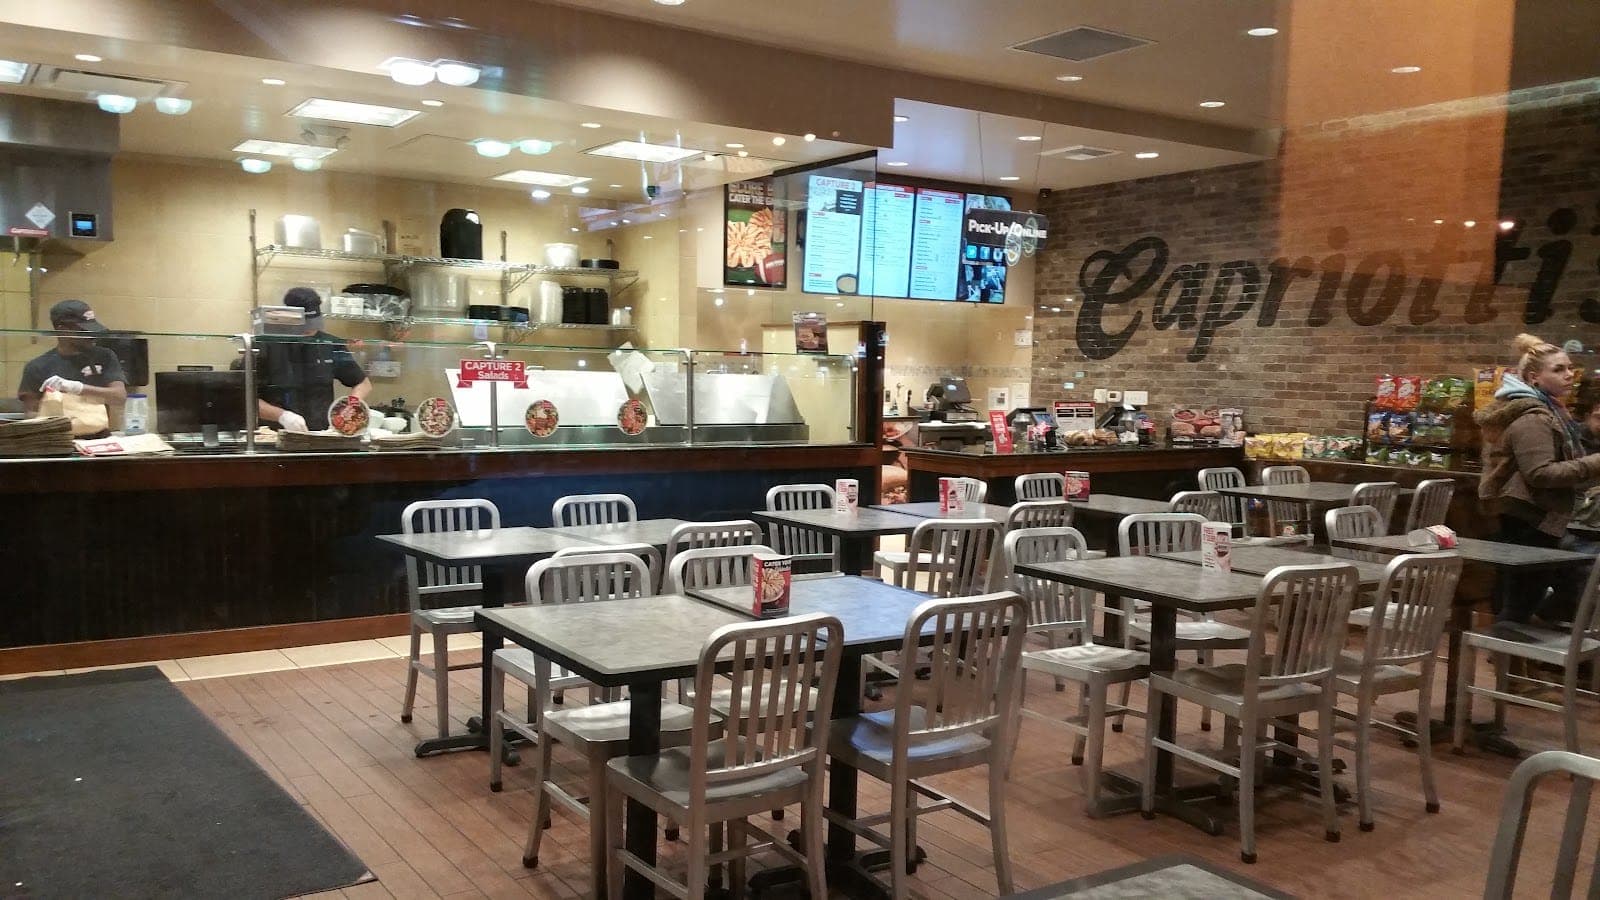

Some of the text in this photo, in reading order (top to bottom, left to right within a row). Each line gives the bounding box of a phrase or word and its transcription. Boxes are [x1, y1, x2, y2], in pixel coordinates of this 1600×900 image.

[815, 178, 849, 189] CAPTURE
[464, 361, 522, 371] CAPTURE 2
[477, 370, 509, 380] Salads
